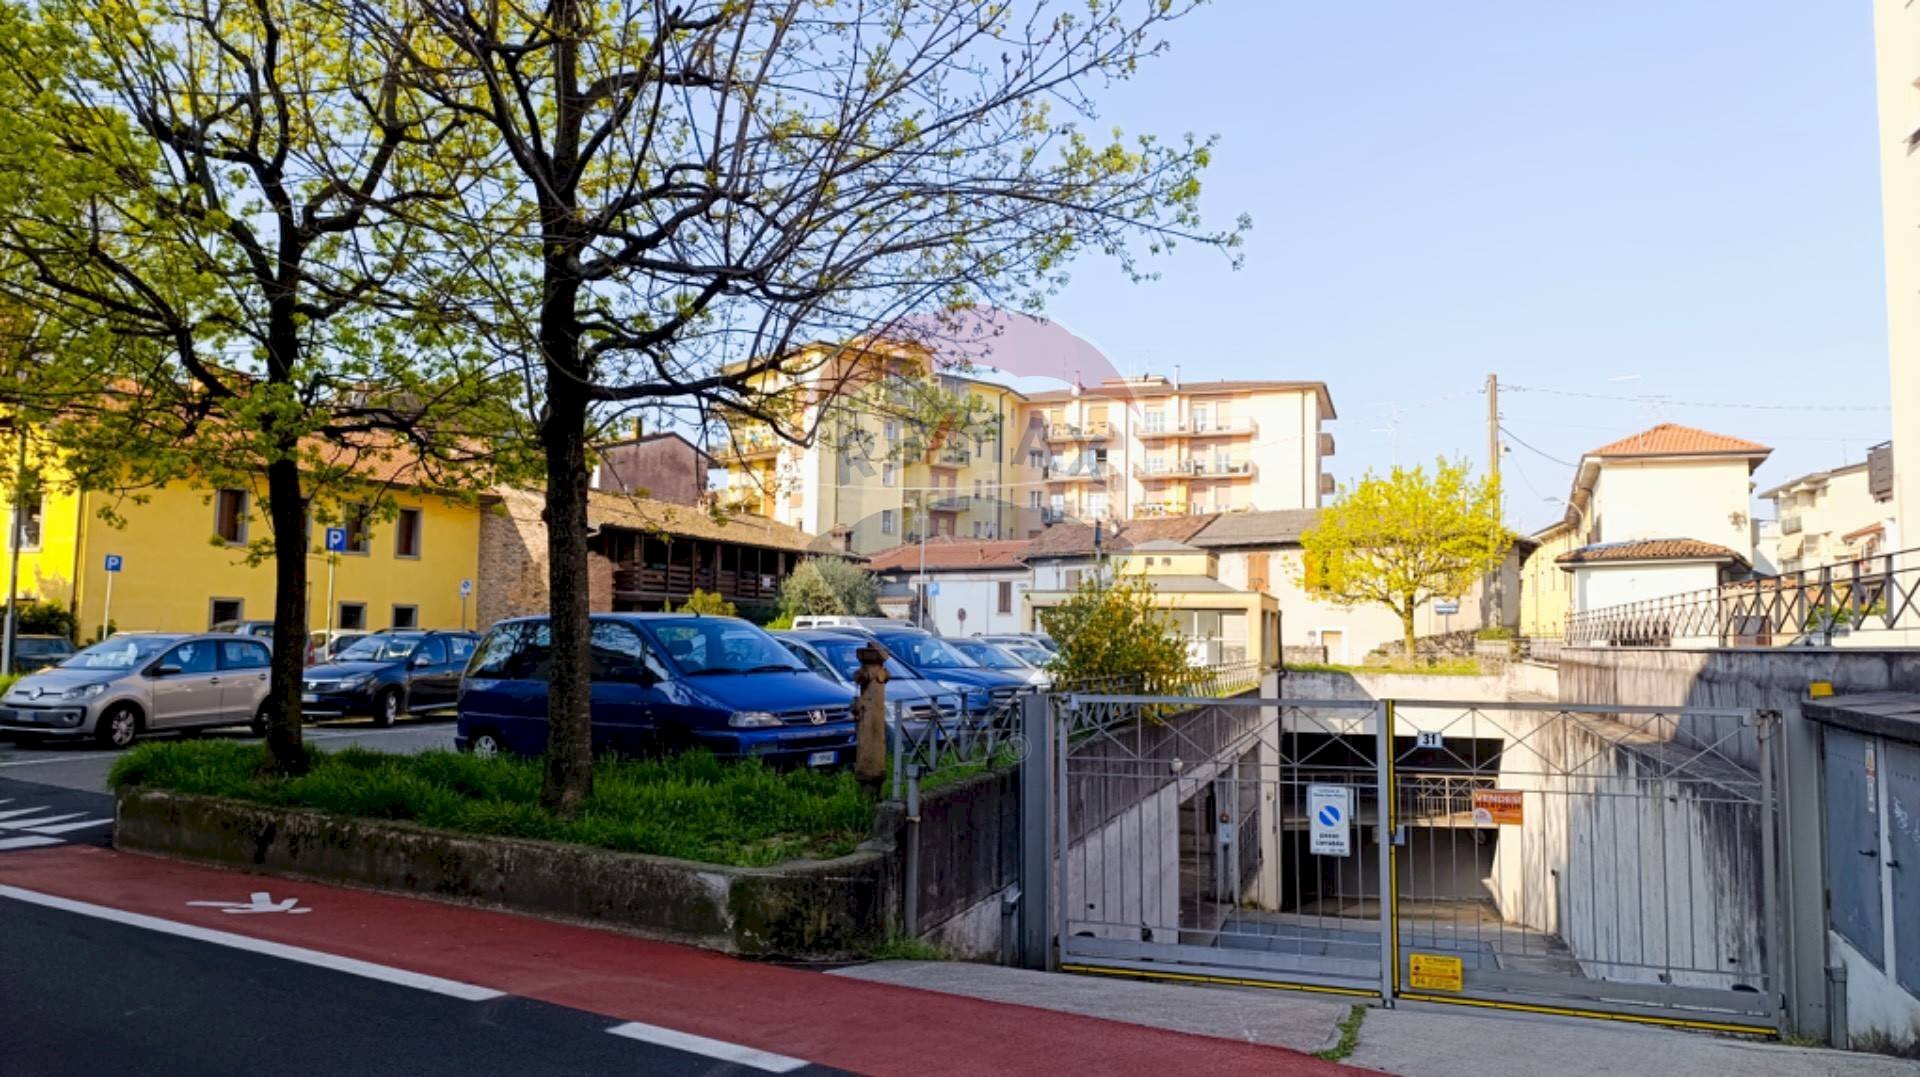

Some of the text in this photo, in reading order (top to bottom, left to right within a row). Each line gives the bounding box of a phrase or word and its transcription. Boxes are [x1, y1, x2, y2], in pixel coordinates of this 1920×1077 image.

[330, 531, 342, 547] P
[109, 557, 119, 569] P
[1423, 734, 1436, 745] 31
[1475, 794, 1521, 804] VENDESI
